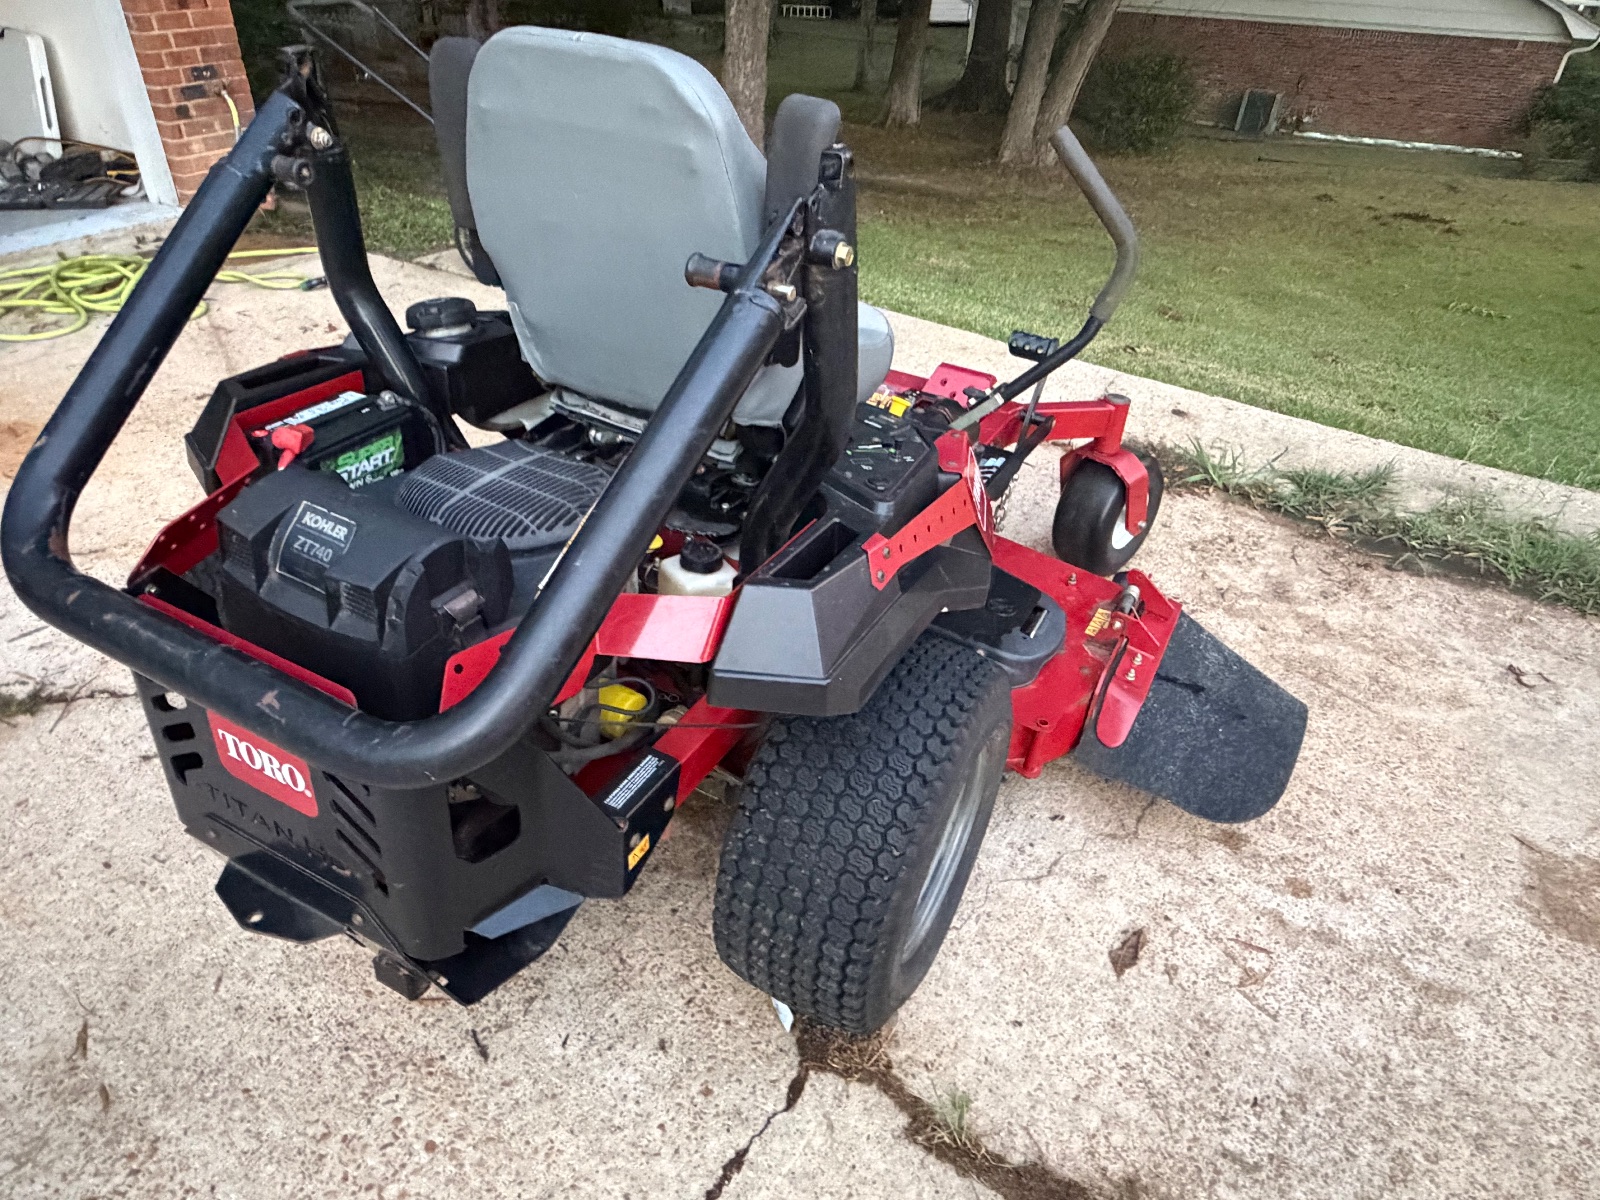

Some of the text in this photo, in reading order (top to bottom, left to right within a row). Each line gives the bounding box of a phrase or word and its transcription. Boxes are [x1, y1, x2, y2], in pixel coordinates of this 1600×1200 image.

[293, 535, 333, 562] ZT740
[301, 511, 348, 541] KOHLER
[217, 728, 306, 792] TORO
[196, 782, 295, 847] TITAN
